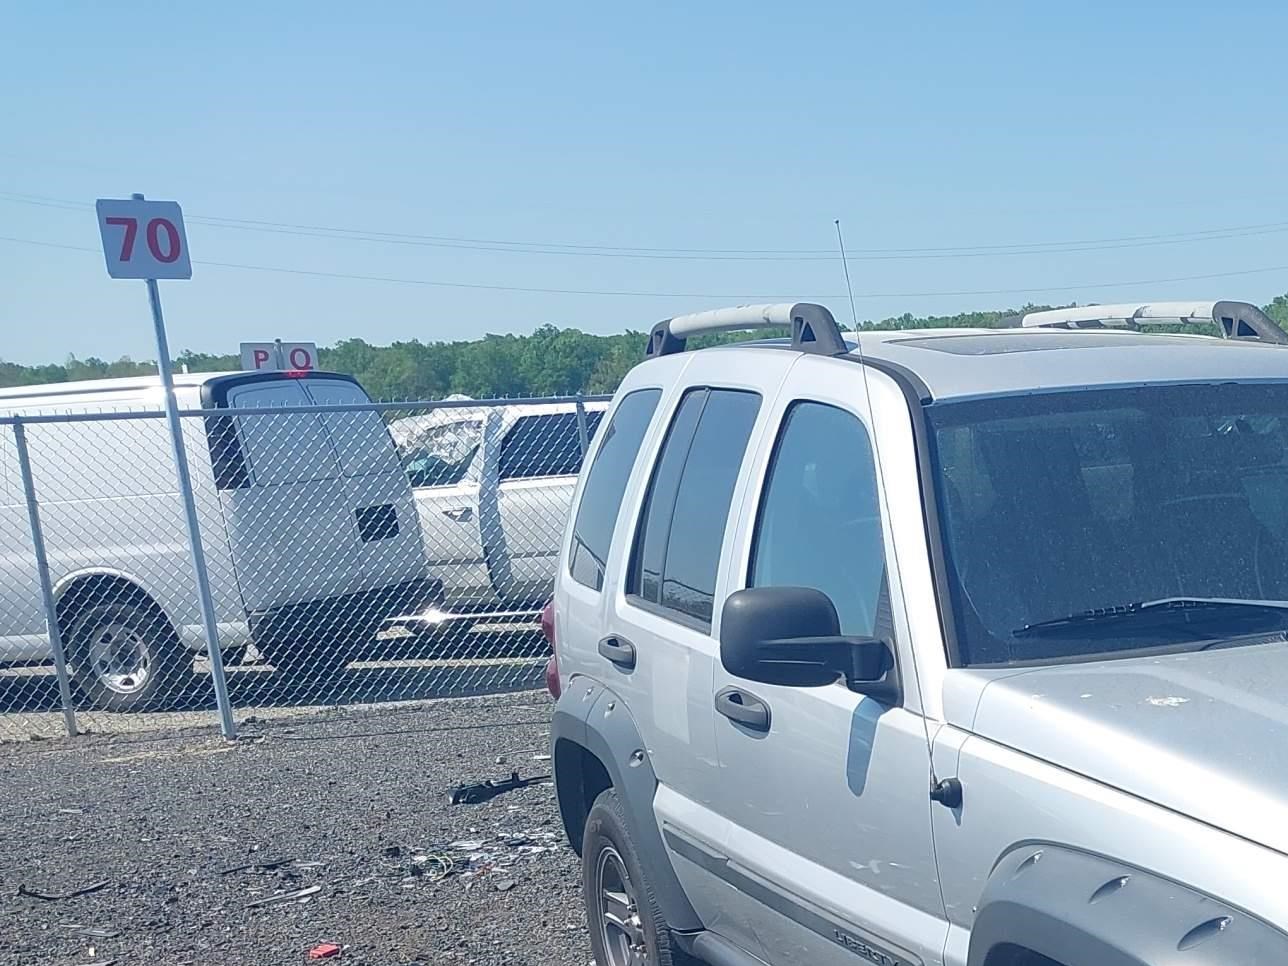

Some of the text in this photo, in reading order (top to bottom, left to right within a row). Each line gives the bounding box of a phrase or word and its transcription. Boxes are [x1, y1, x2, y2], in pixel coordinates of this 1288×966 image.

[105, 217, 181, 264] 70
[253, 348, 313, 371] P Q
